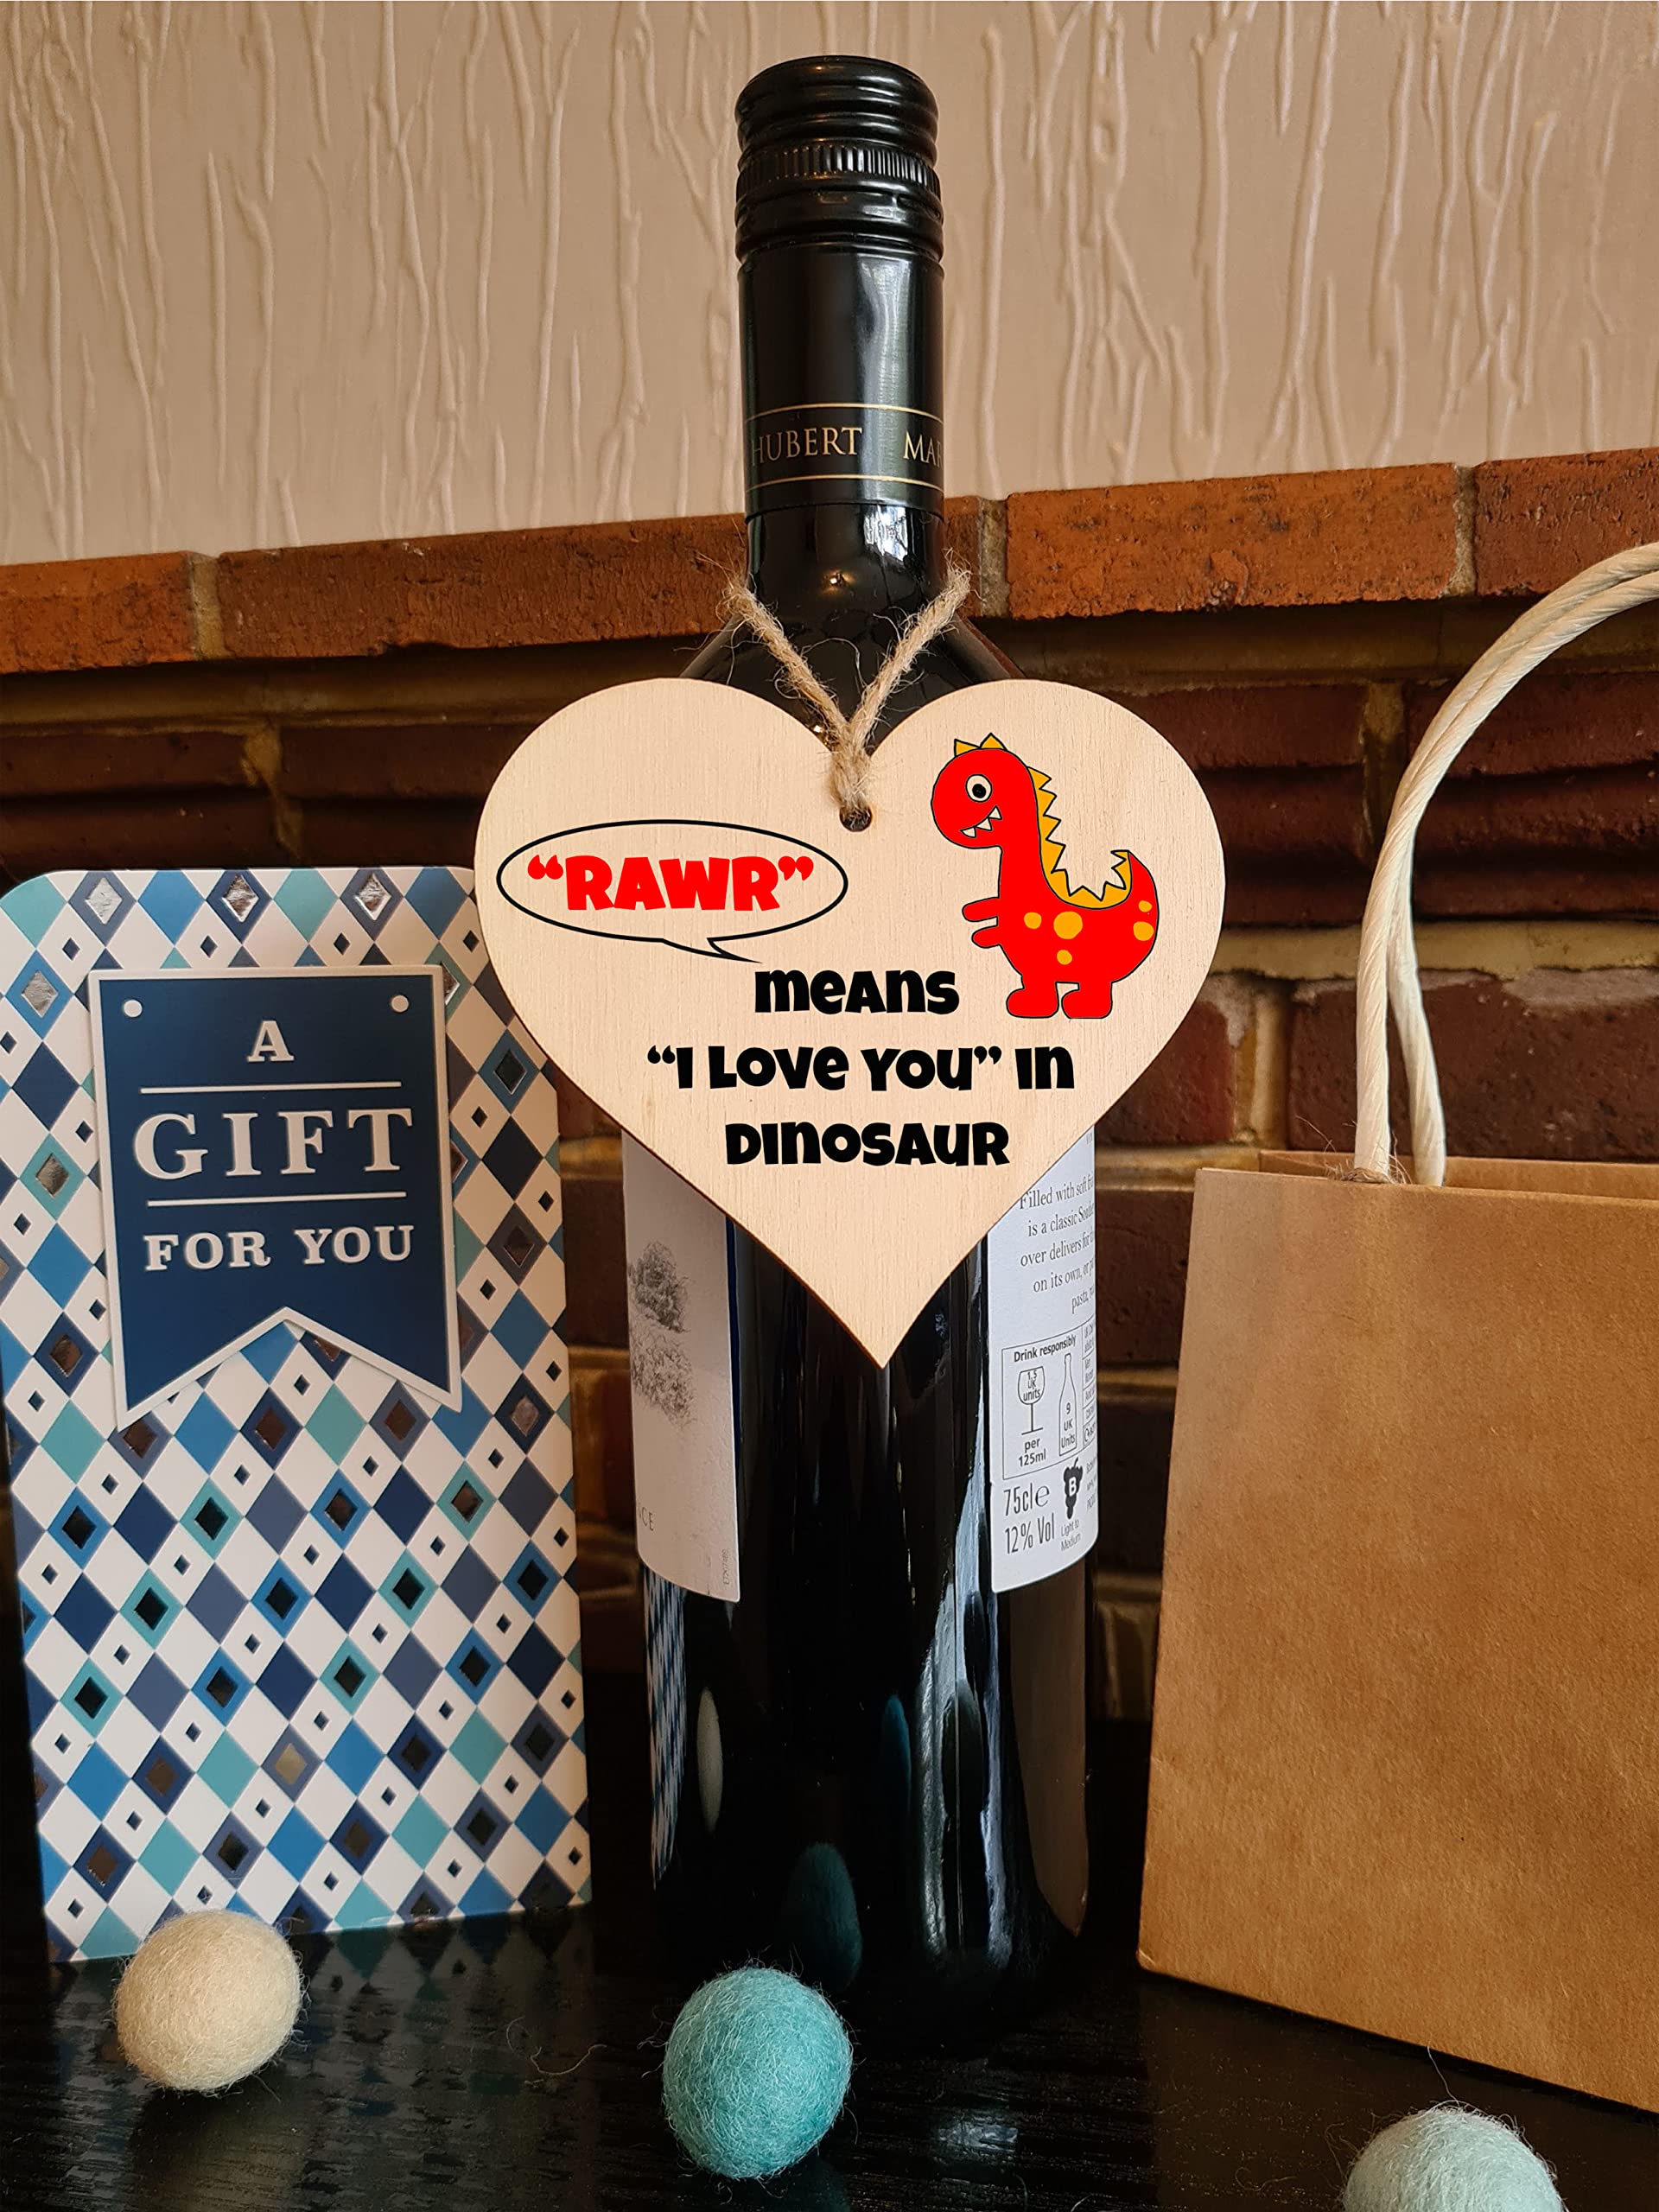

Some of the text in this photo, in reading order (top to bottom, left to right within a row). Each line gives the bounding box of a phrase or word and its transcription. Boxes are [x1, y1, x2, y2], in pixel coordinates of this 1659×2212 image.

[752, 427, 862, 467] HUBERT
[246, 1020, 295, 1063] A
[134, 1107, 413, 1180] GIFT
[1056, 1181, 1075, 1202] with
[1027, 1219, 1038, 1237] is
[1041, 1222, 1047, 1235] a
[1050, 1210, 1077, 1232] classic
[143, 1224, 415, 1272] FOR YOU
[1020, 1250, 1046, 1268] over
[1049, 1238, 1082, 1261] delivers
[1033, 1279, 1048, 1294] on
[1051, 1271, 1063, 1289] its
[1014, 1345, 1038, 1363] Drink
[1039, 1335, 1077, 1357] responsibly
[1022, 1387, 1041, 1402] units
[1027, 1380, 1037, 1389] UK
[1065, 1402, 1071, 1415] 9
[1064, 1418, 1073, 1432] UK
[1024, 1438, 1040, 1453] per
[1061, 1434, 1076, 1449] Units
[1018, 1448, 1046, 1468] 125ml
[1068, 1476, 1077, 1497] B
[1004, 1513, 1055, 1555] 12% Vol
[1060, 1522, 1074, 1538] Light
